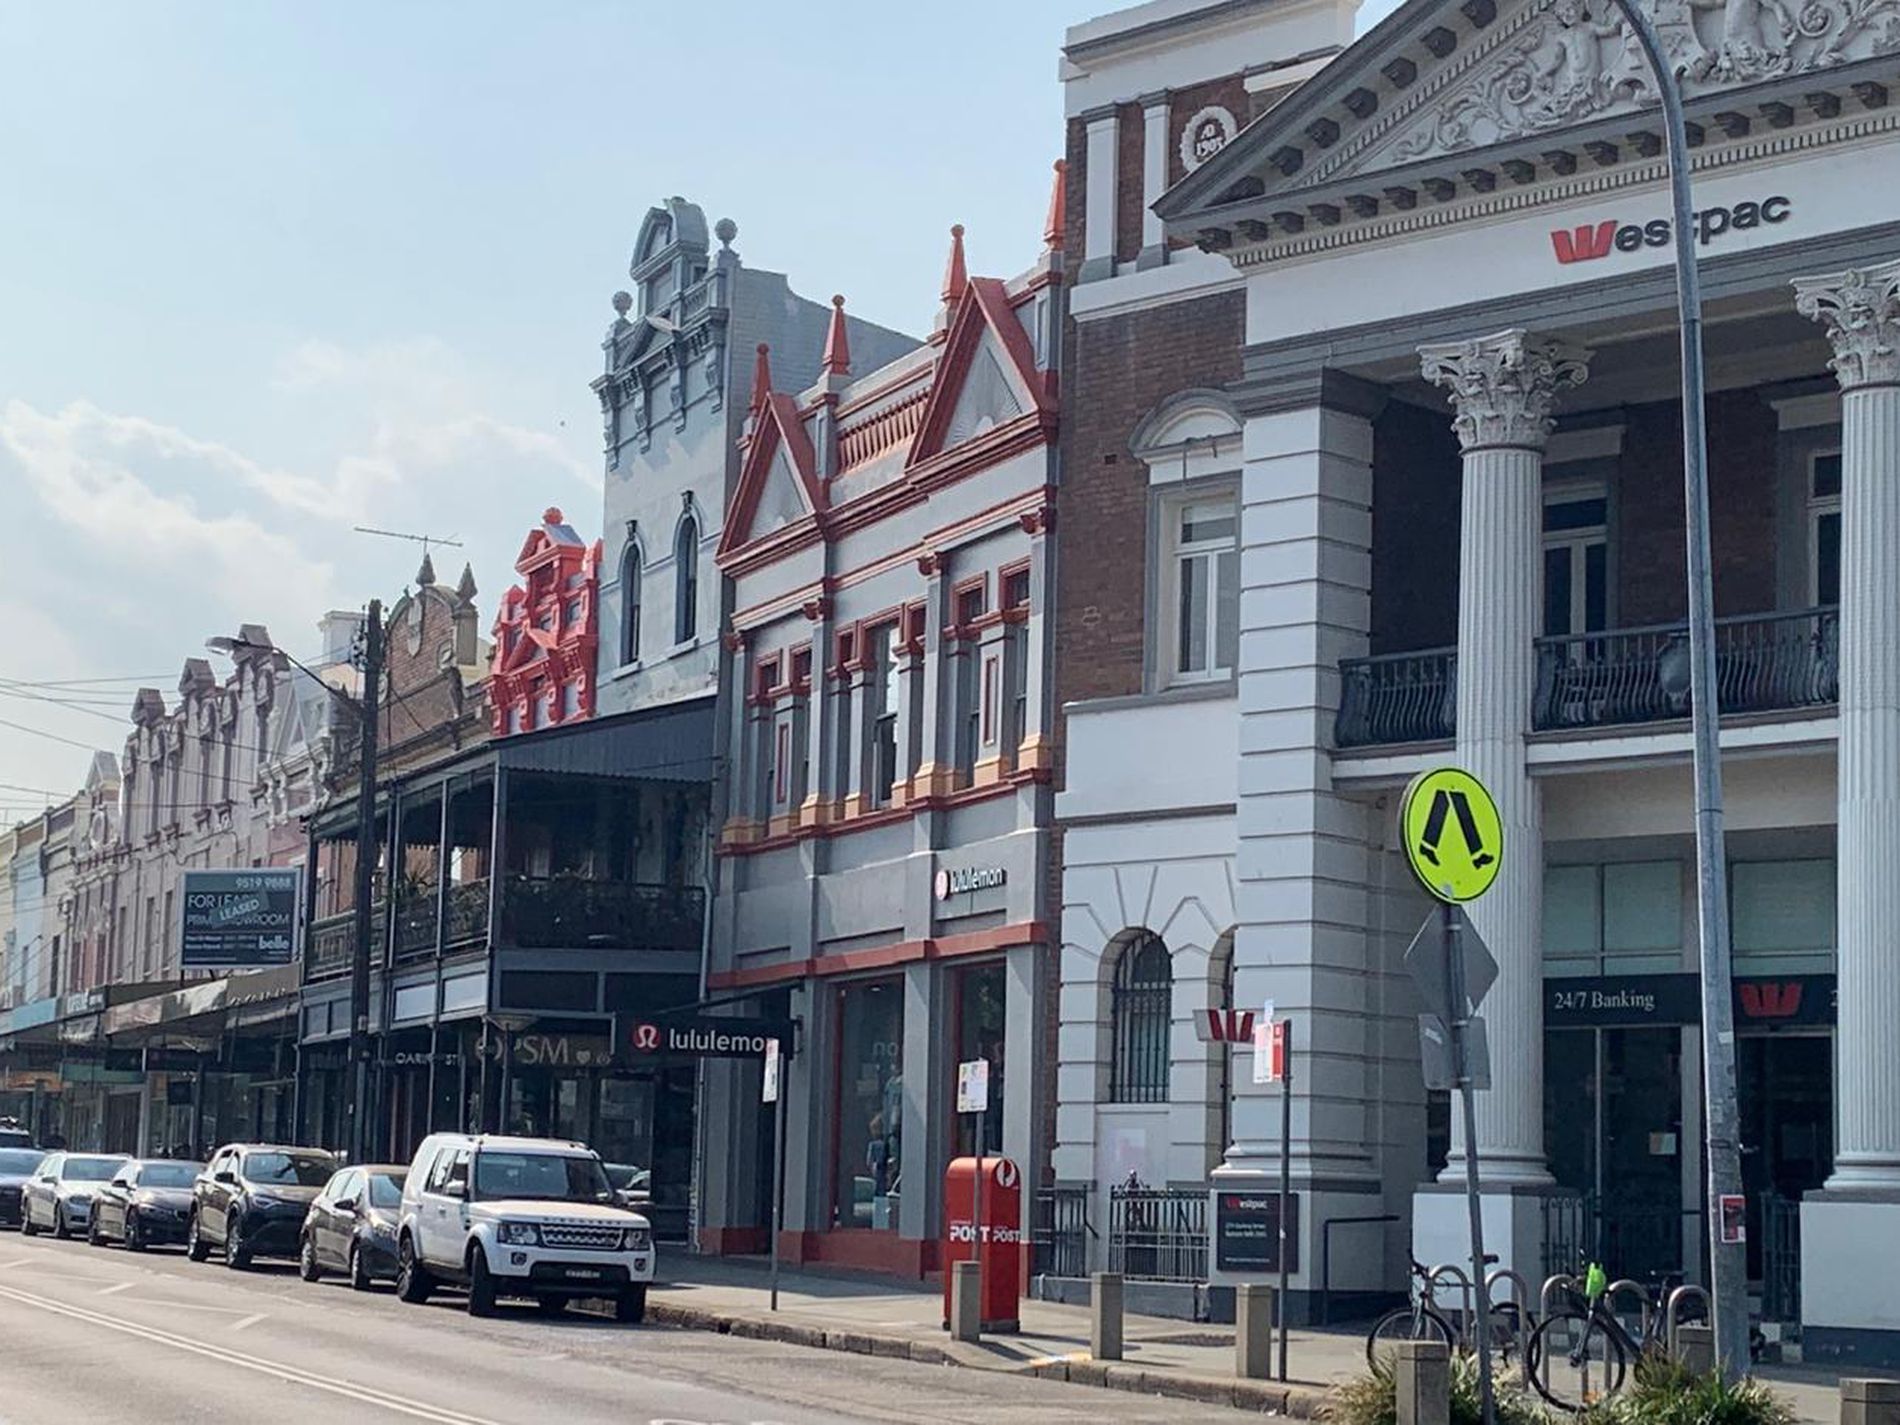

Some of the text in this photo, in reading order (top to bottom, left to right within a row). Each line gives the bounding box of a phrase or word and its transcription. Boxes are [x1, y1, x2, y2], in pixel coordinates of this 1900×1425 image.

[949, 867, 1003, 893] lululemon
[188, 894, 216, 909] FOR
[219, 898, 260, 921] LEASED
[259, 935, 290, 950] belle
[1554, 990, 1655, 1011] 24/7 Banking
[669, 1027, 766, 1053] lululemo
[992, 1229, 1022, 1243] POST
